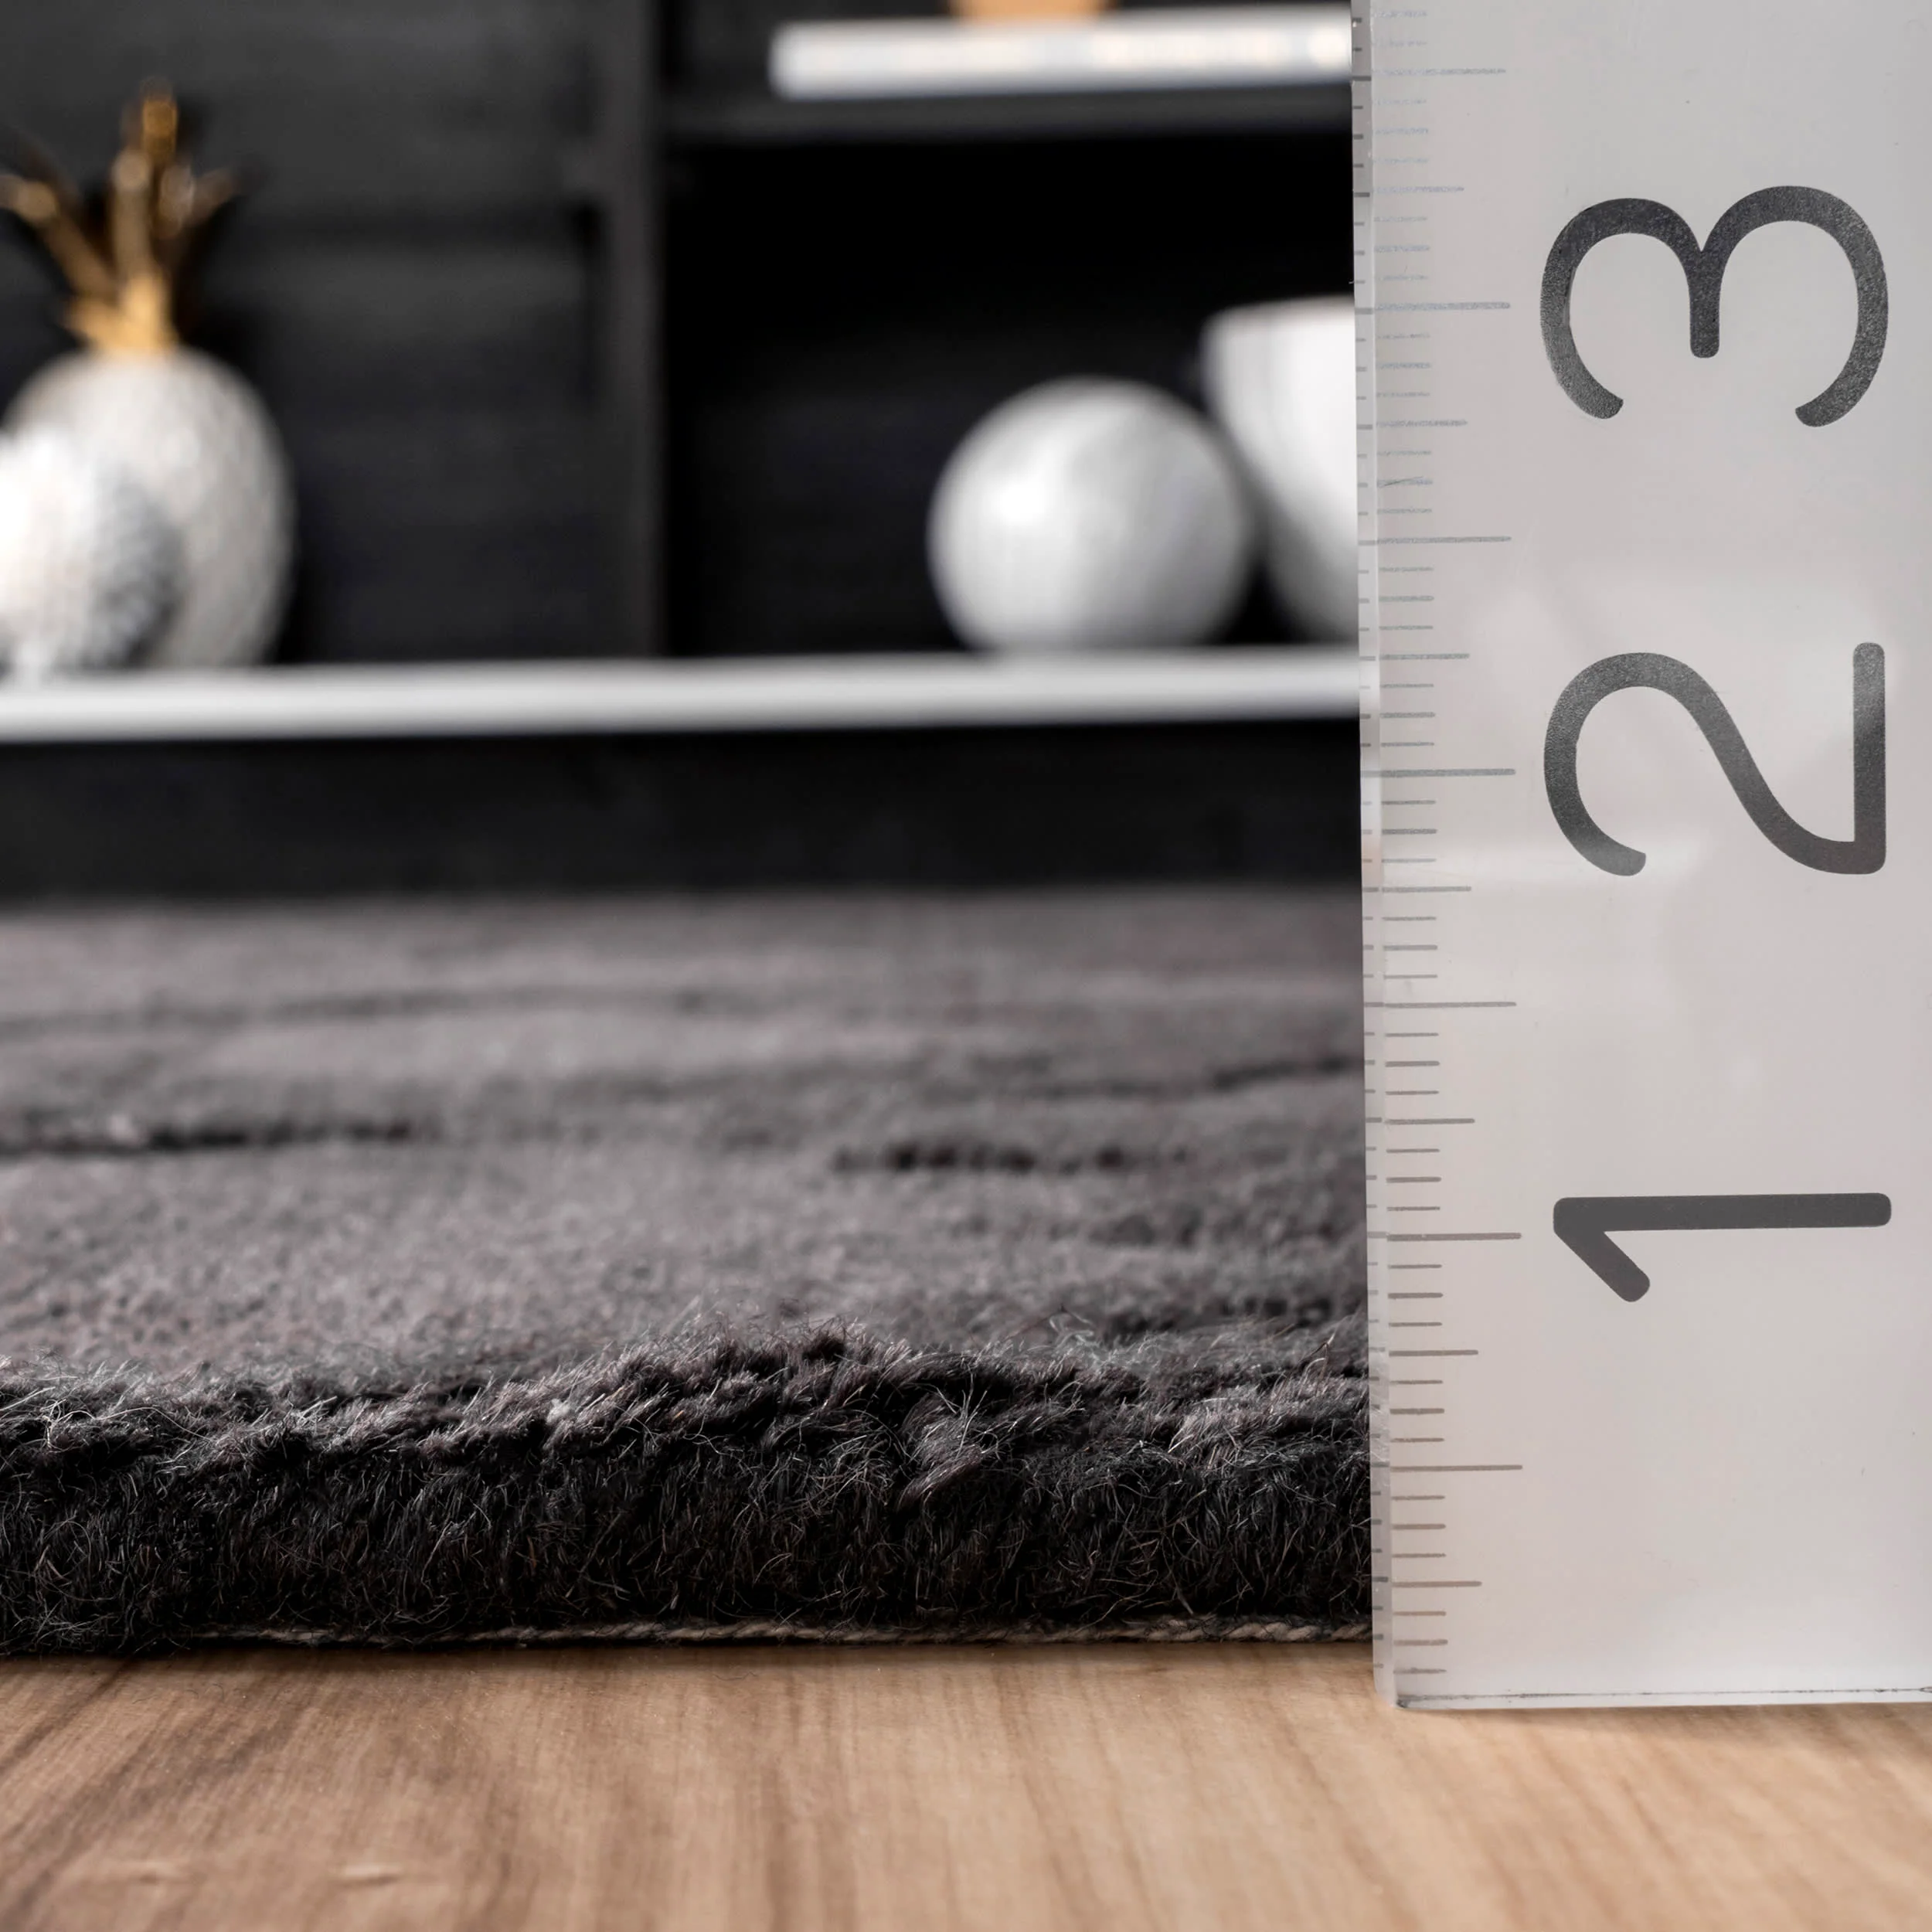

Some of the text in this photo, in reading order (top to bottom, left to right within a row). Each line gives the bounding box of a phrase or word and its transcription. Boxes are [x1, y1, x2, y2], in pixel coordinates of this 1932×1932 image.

[1540, 185, 1889, 427] 3
[1543, 642, 1886, 876] 2
[1553, 1192, 1892, 1302] 1
